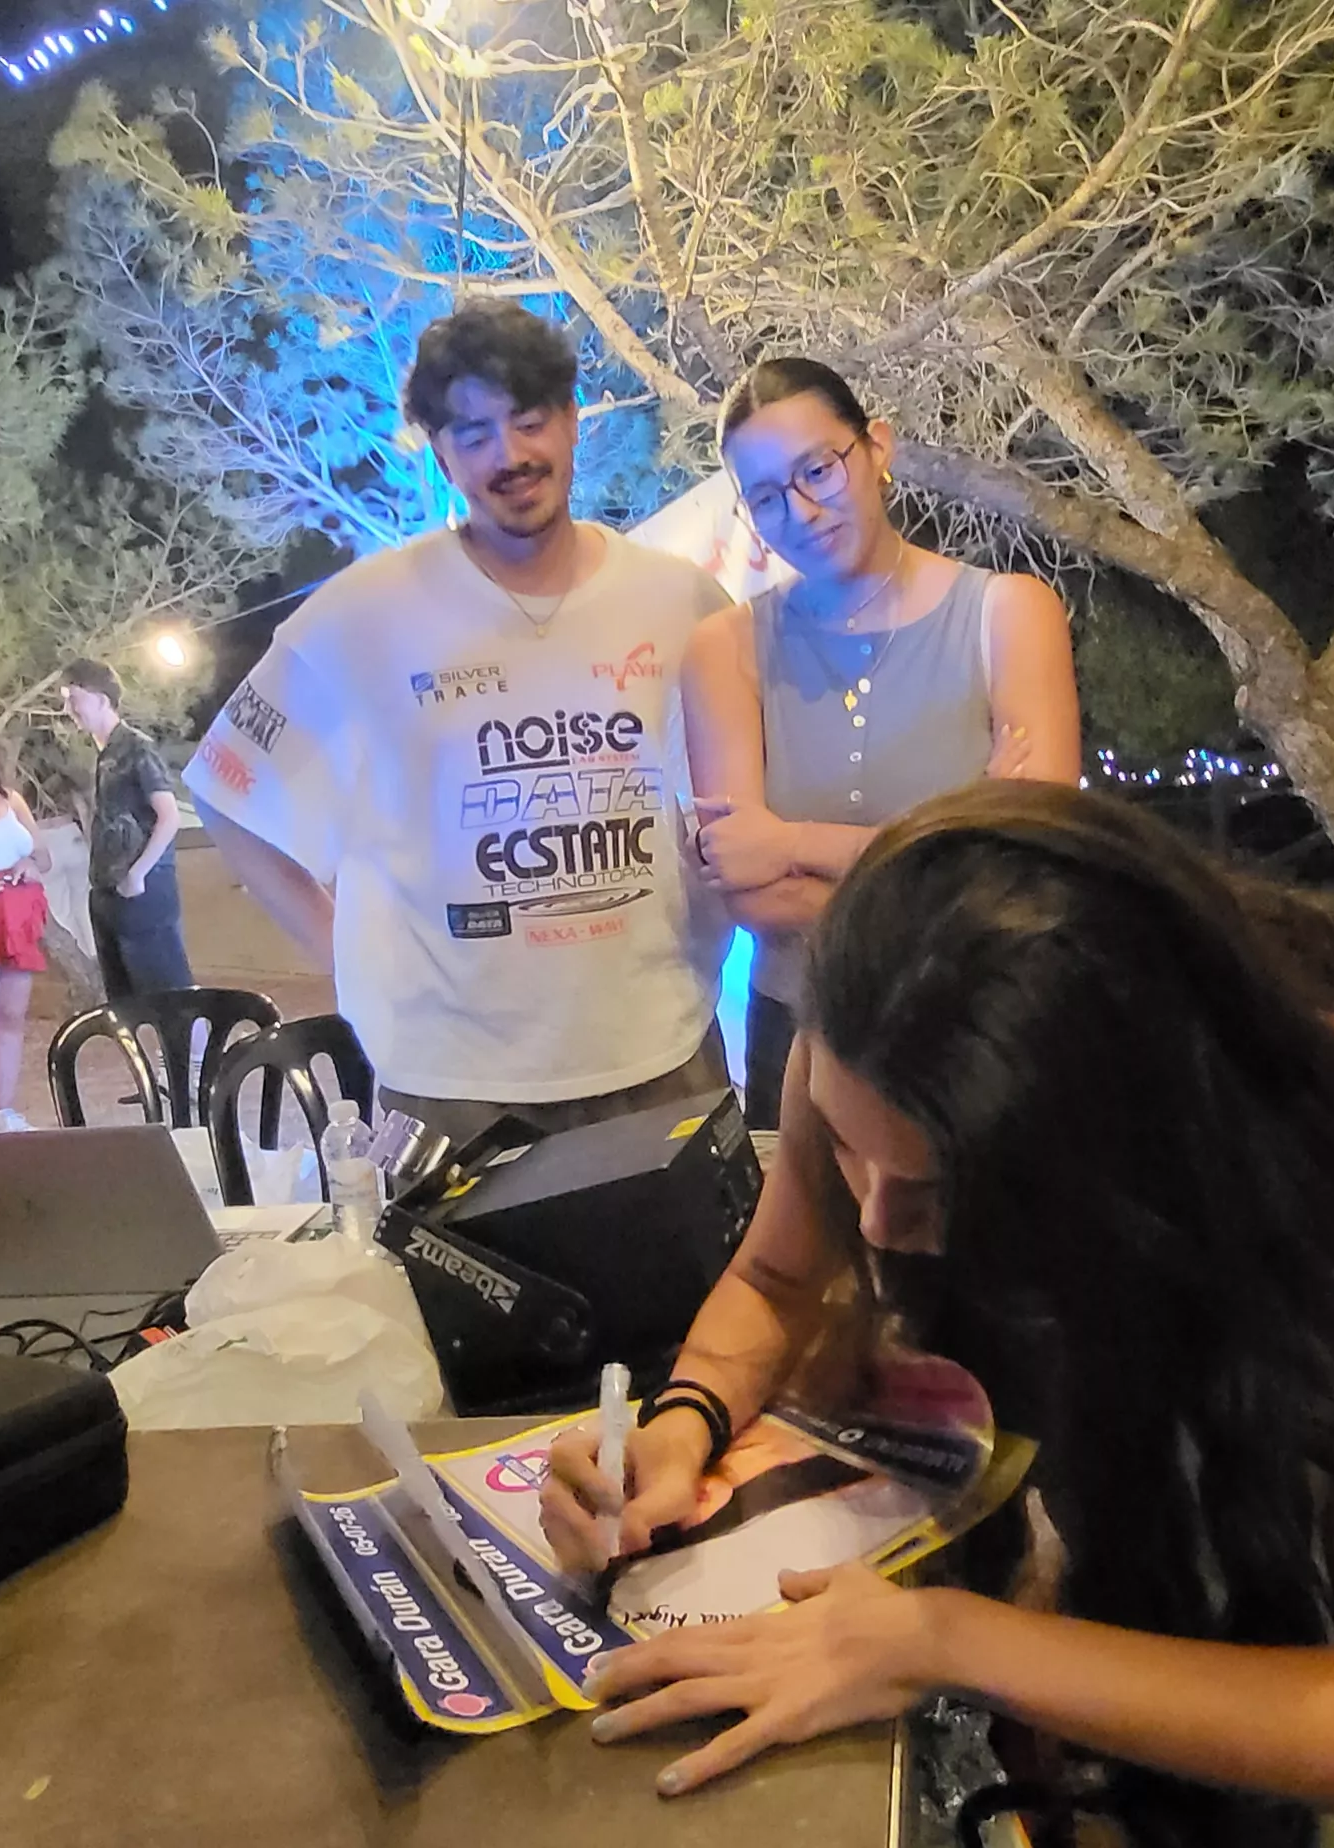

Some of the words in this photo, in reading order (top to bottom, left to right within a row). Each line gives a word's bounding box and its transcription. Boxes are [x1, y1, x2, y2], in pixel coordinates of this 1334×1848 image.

[416, 679, 509, 707] TRACE
[438, 664, 501, 685] SILVER
[476, 709, 644, 768] noise
[460, 767, 664, 830] DATA
[475, 816, 655, 883] ECSTATIC
[482, 864, 655, 898] TECHNOTOPIA
[467, 1537, 546, 1601] Durán
[370, 1570, 432, 1632] Durán
[532, 1598, 603, 1657] Gara
[622, 1603, 688, 1628] Miguel
[413, 1634, 470, 1691] Gara
